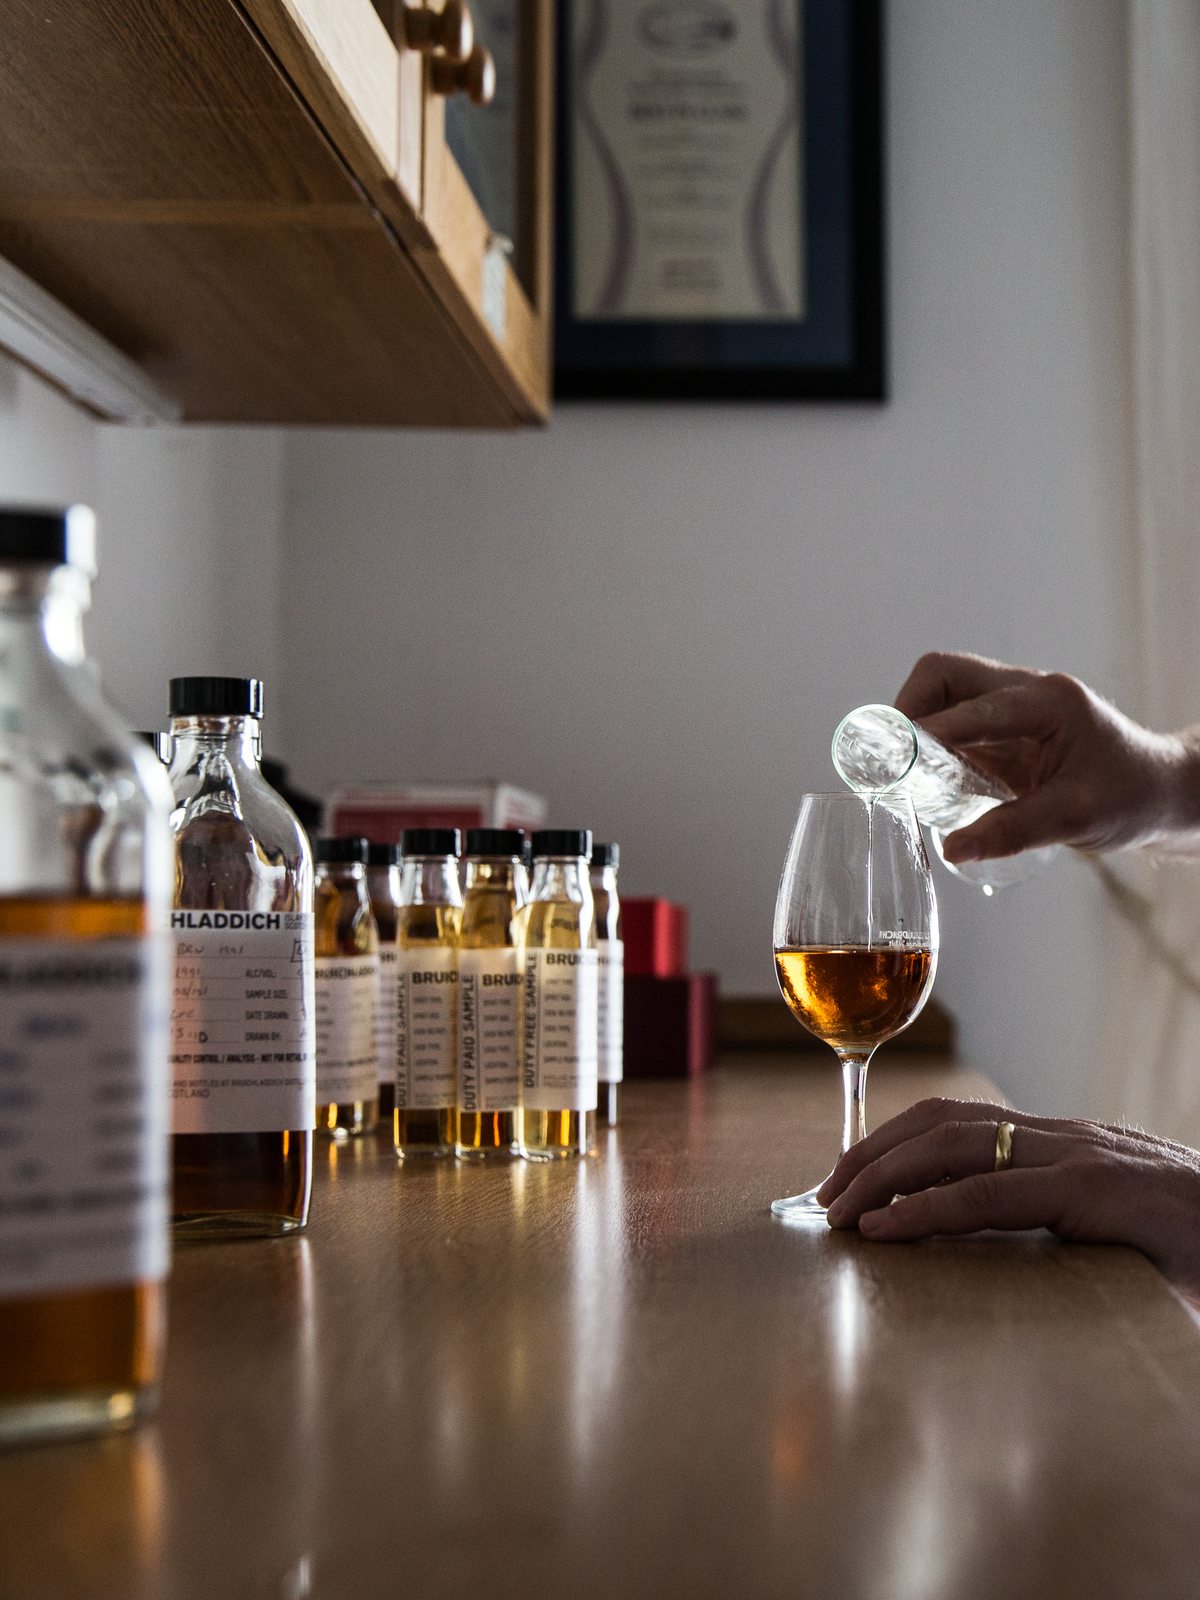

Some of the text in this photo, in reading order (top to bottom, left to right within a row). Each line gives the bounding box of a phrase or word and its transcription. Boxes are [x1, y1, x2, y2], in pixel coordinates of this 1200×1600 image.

[170, 911, 280, 930] HLADDICH
[461, 974, 476, 1111] DUTY PAID SAMPLE
[524, 953, 537, 1088] DUTY FREE SAMPLE
